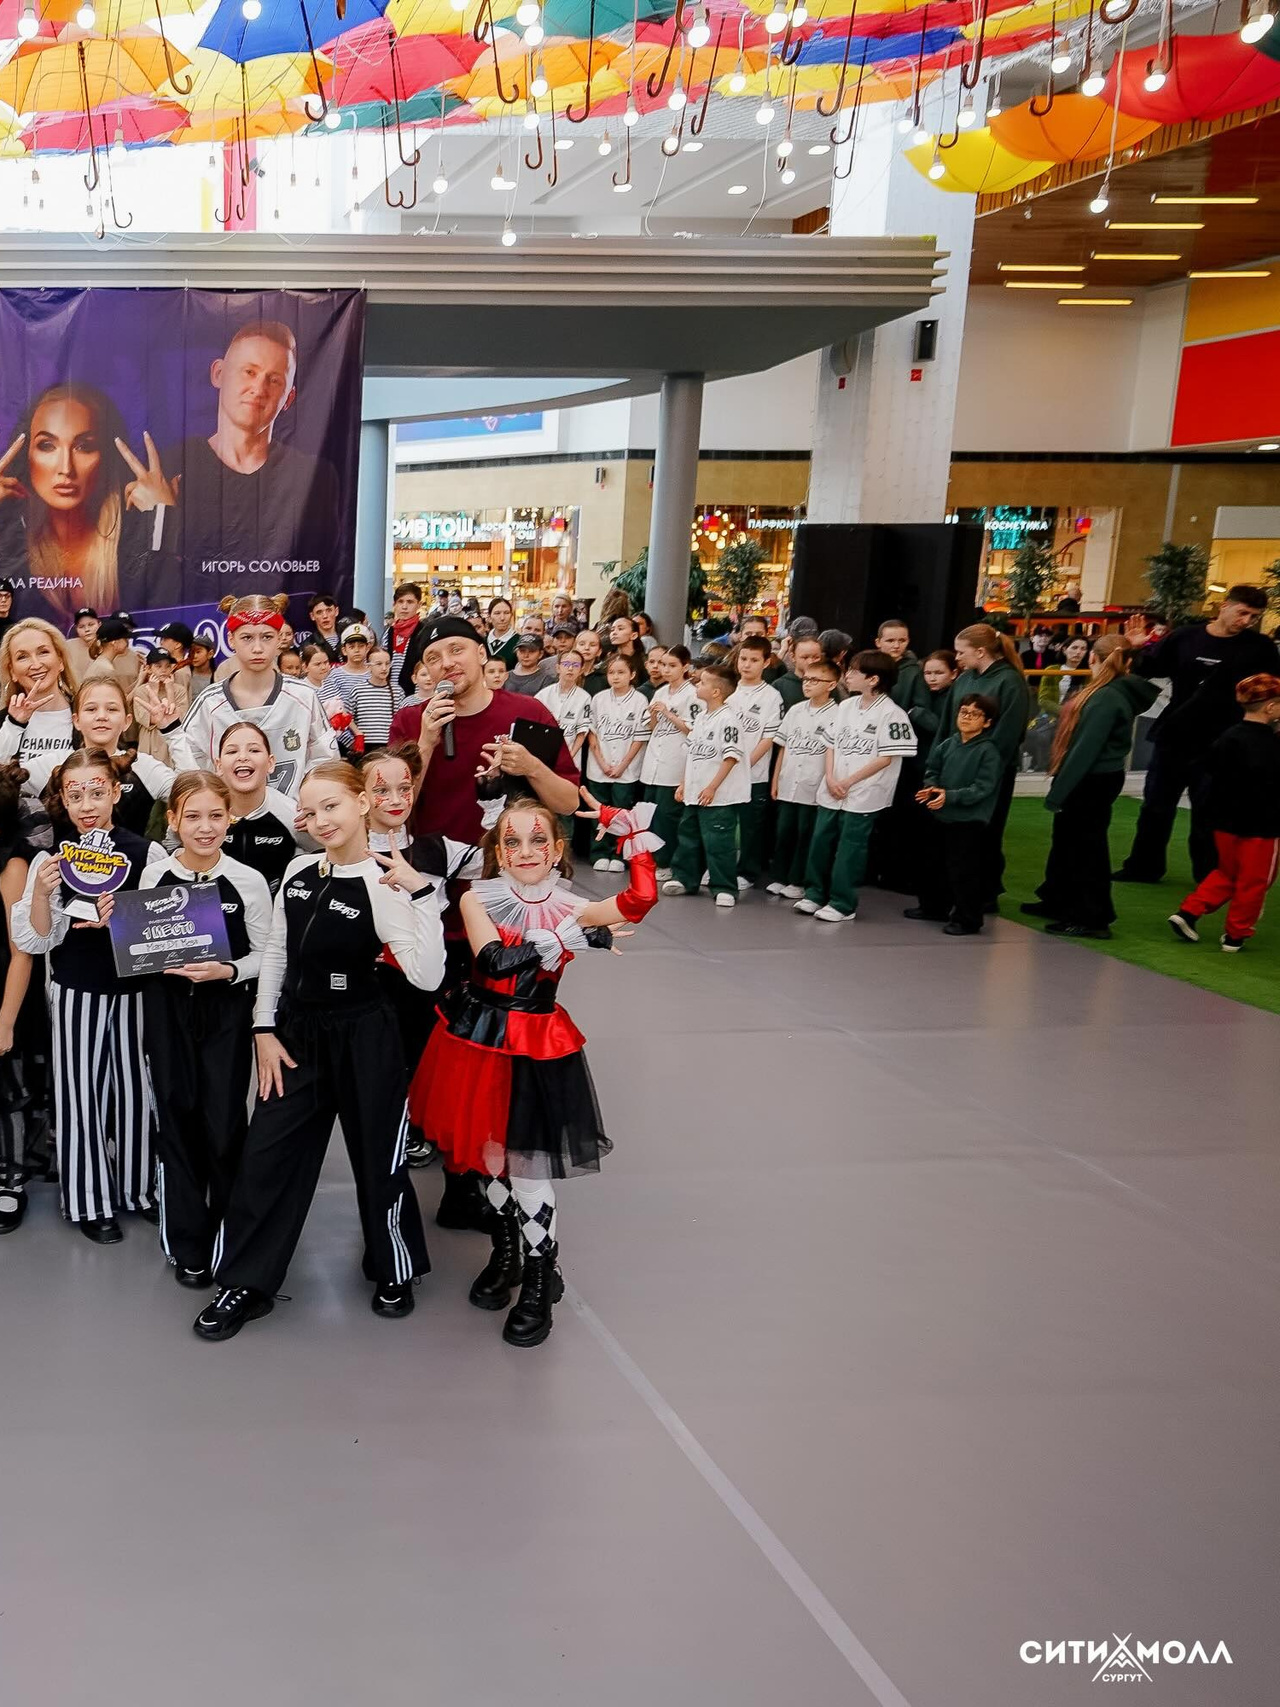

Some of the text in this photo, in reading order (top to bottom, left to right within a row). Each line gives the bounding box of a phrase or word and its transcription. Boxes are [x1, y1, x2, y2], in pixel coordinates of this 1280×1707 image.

[984, 520, 1048, 531] КОСМЕТИКА
[201, 560, 320, 573] ИГОРЬ СОЛОВЬЕВ
[28, 576, 84, 590] РЕДИНА
